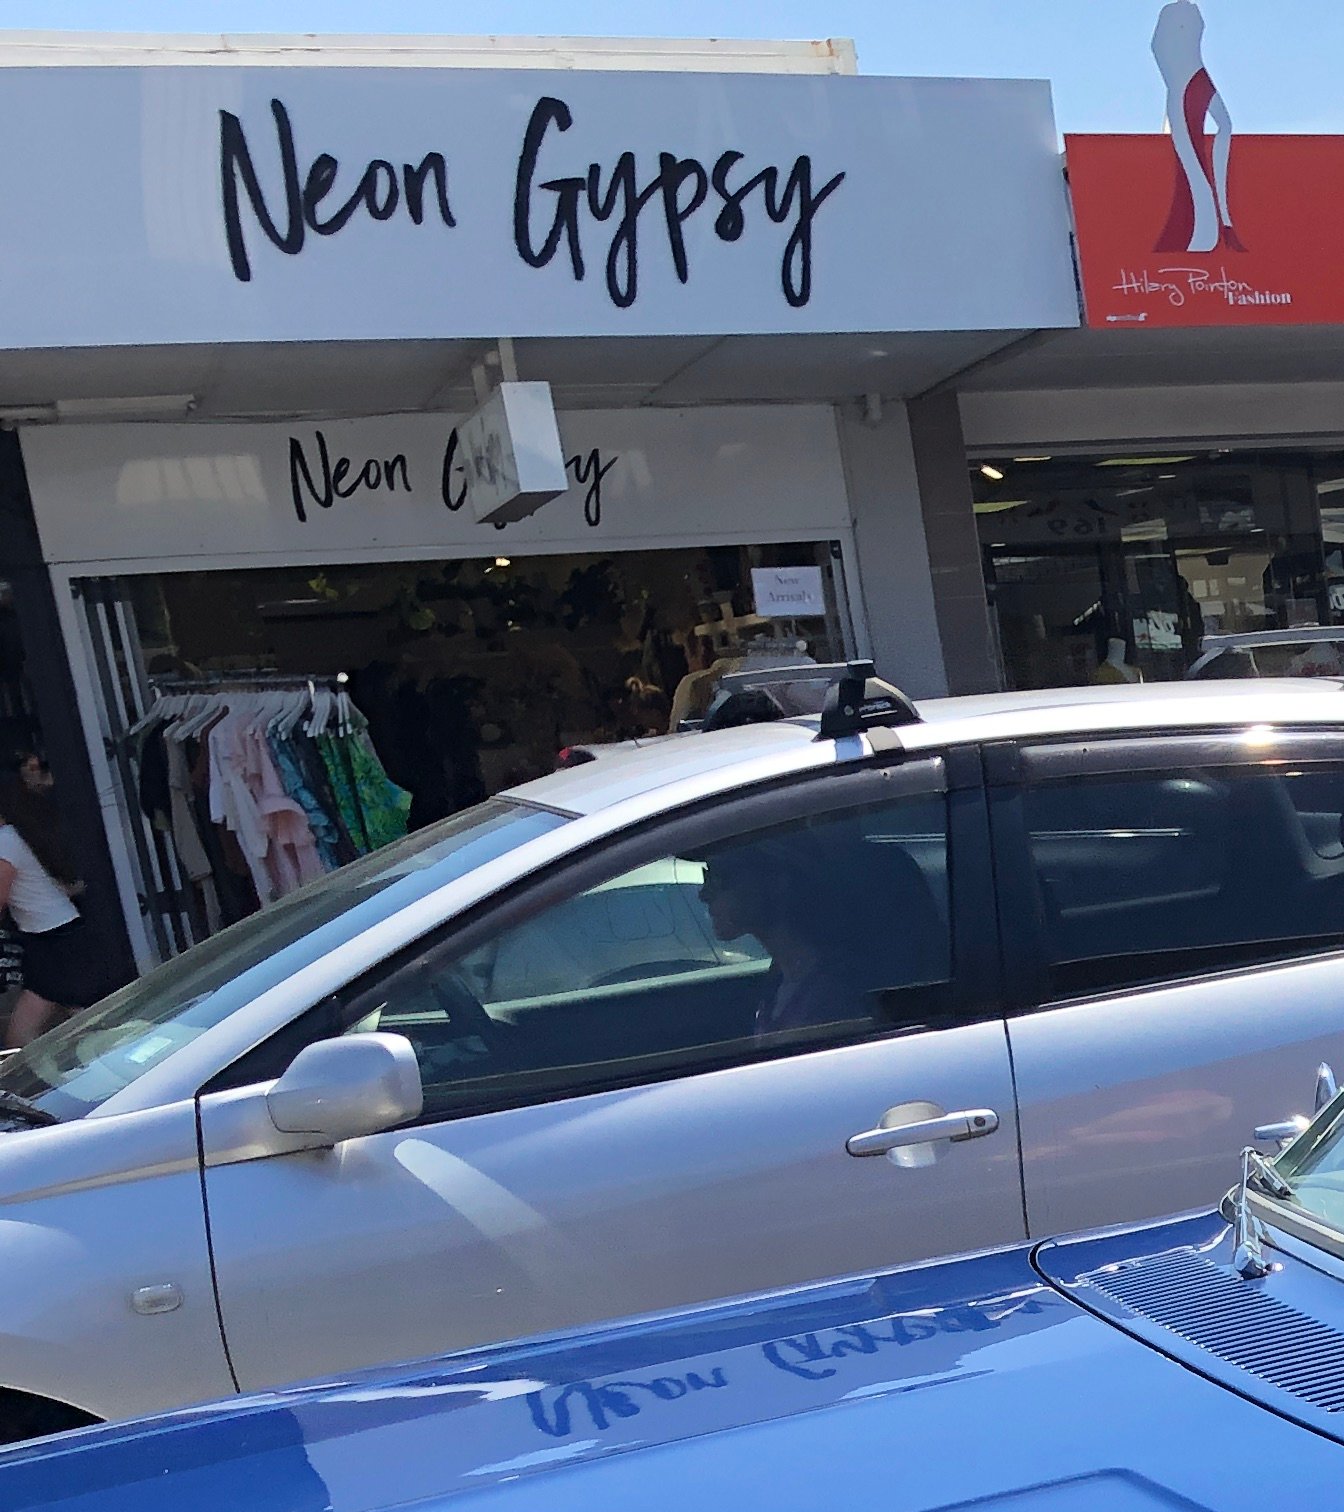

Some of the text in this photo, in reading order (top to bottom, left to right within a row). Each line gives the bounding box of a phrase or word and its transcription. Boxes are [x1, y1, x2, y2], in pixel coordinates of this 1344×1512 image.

[219, 96, 846, 308] Neon Gypsy
[1112, 266, 1252, 306] Hilary Pointon
[1227, 290, 1292, 306] Fashion
[289, 430, 412, 522] Neon
[774, 574, 800, 585] New
[768, 590, 814, 603] Arrivals
